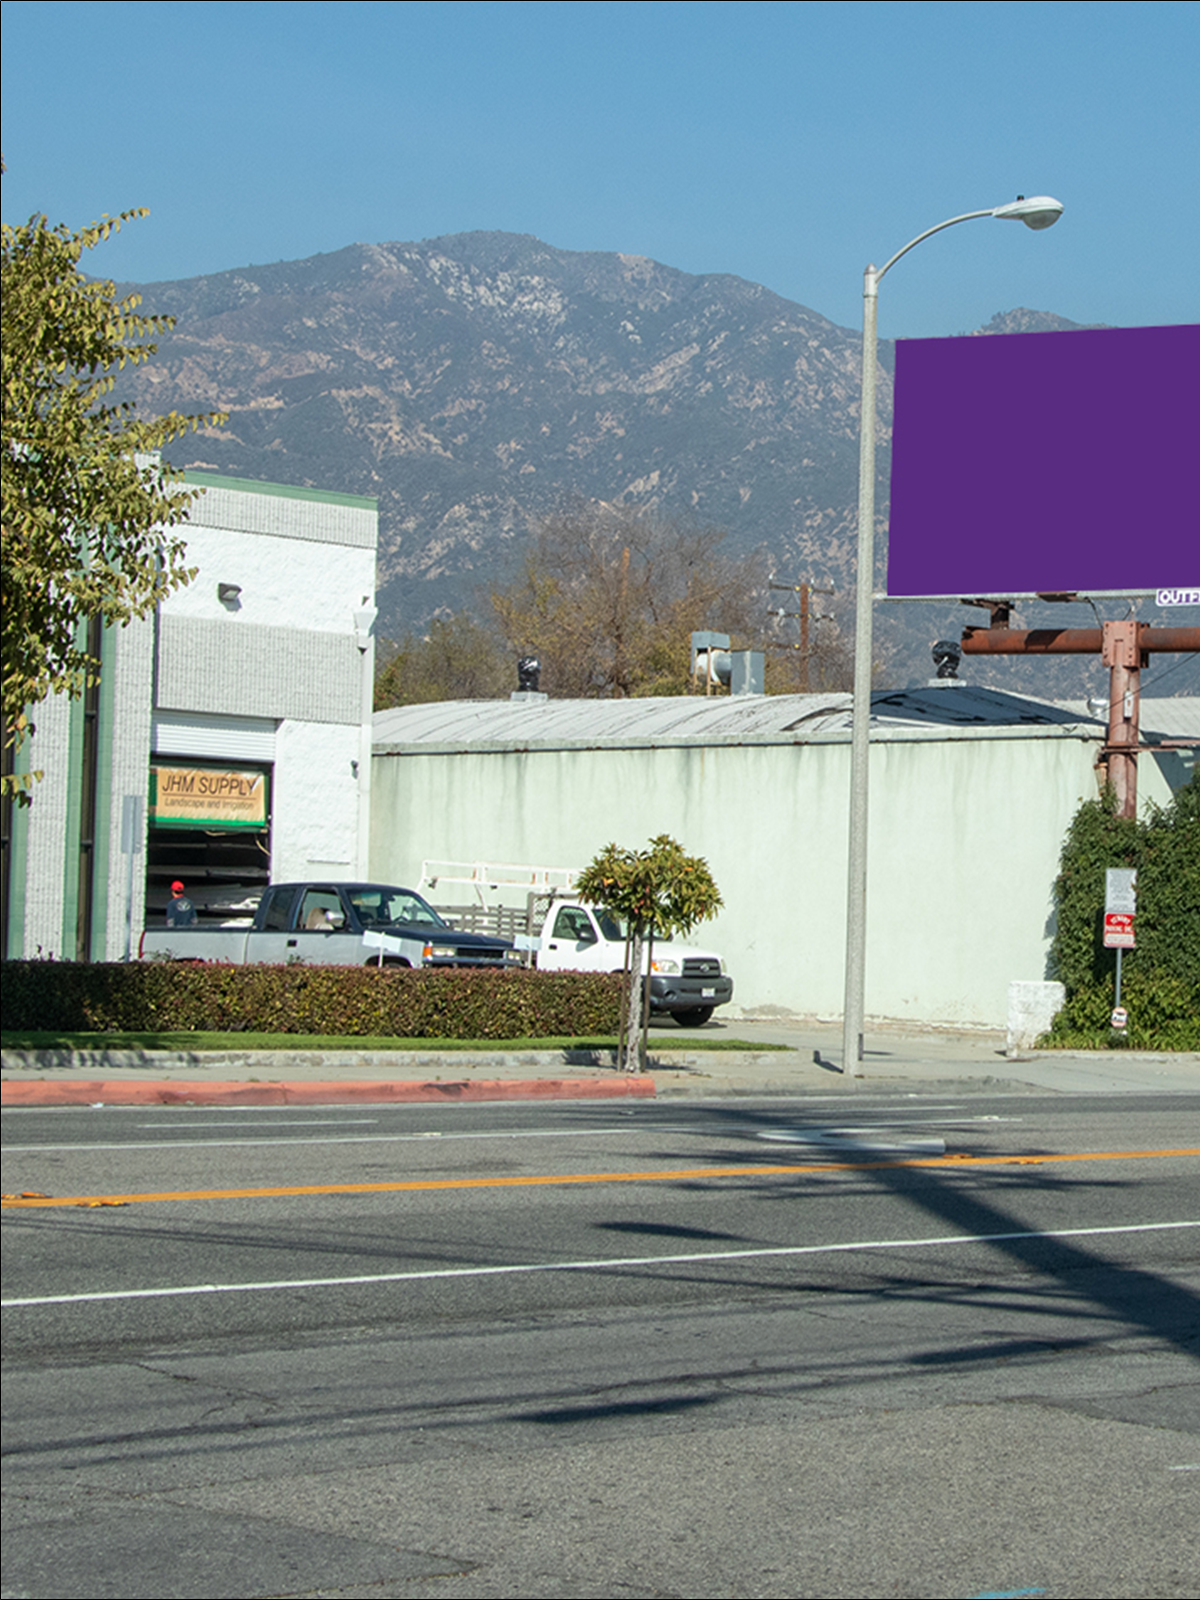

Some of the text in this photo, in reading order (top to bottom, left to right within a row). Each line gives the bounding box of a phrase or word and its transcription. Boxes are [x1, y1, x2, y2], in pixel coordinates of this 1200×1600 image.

[162, 775, 256, 796] JHM SUPPLY
[165, 797, 254, 812] Landscape and Irrigation
